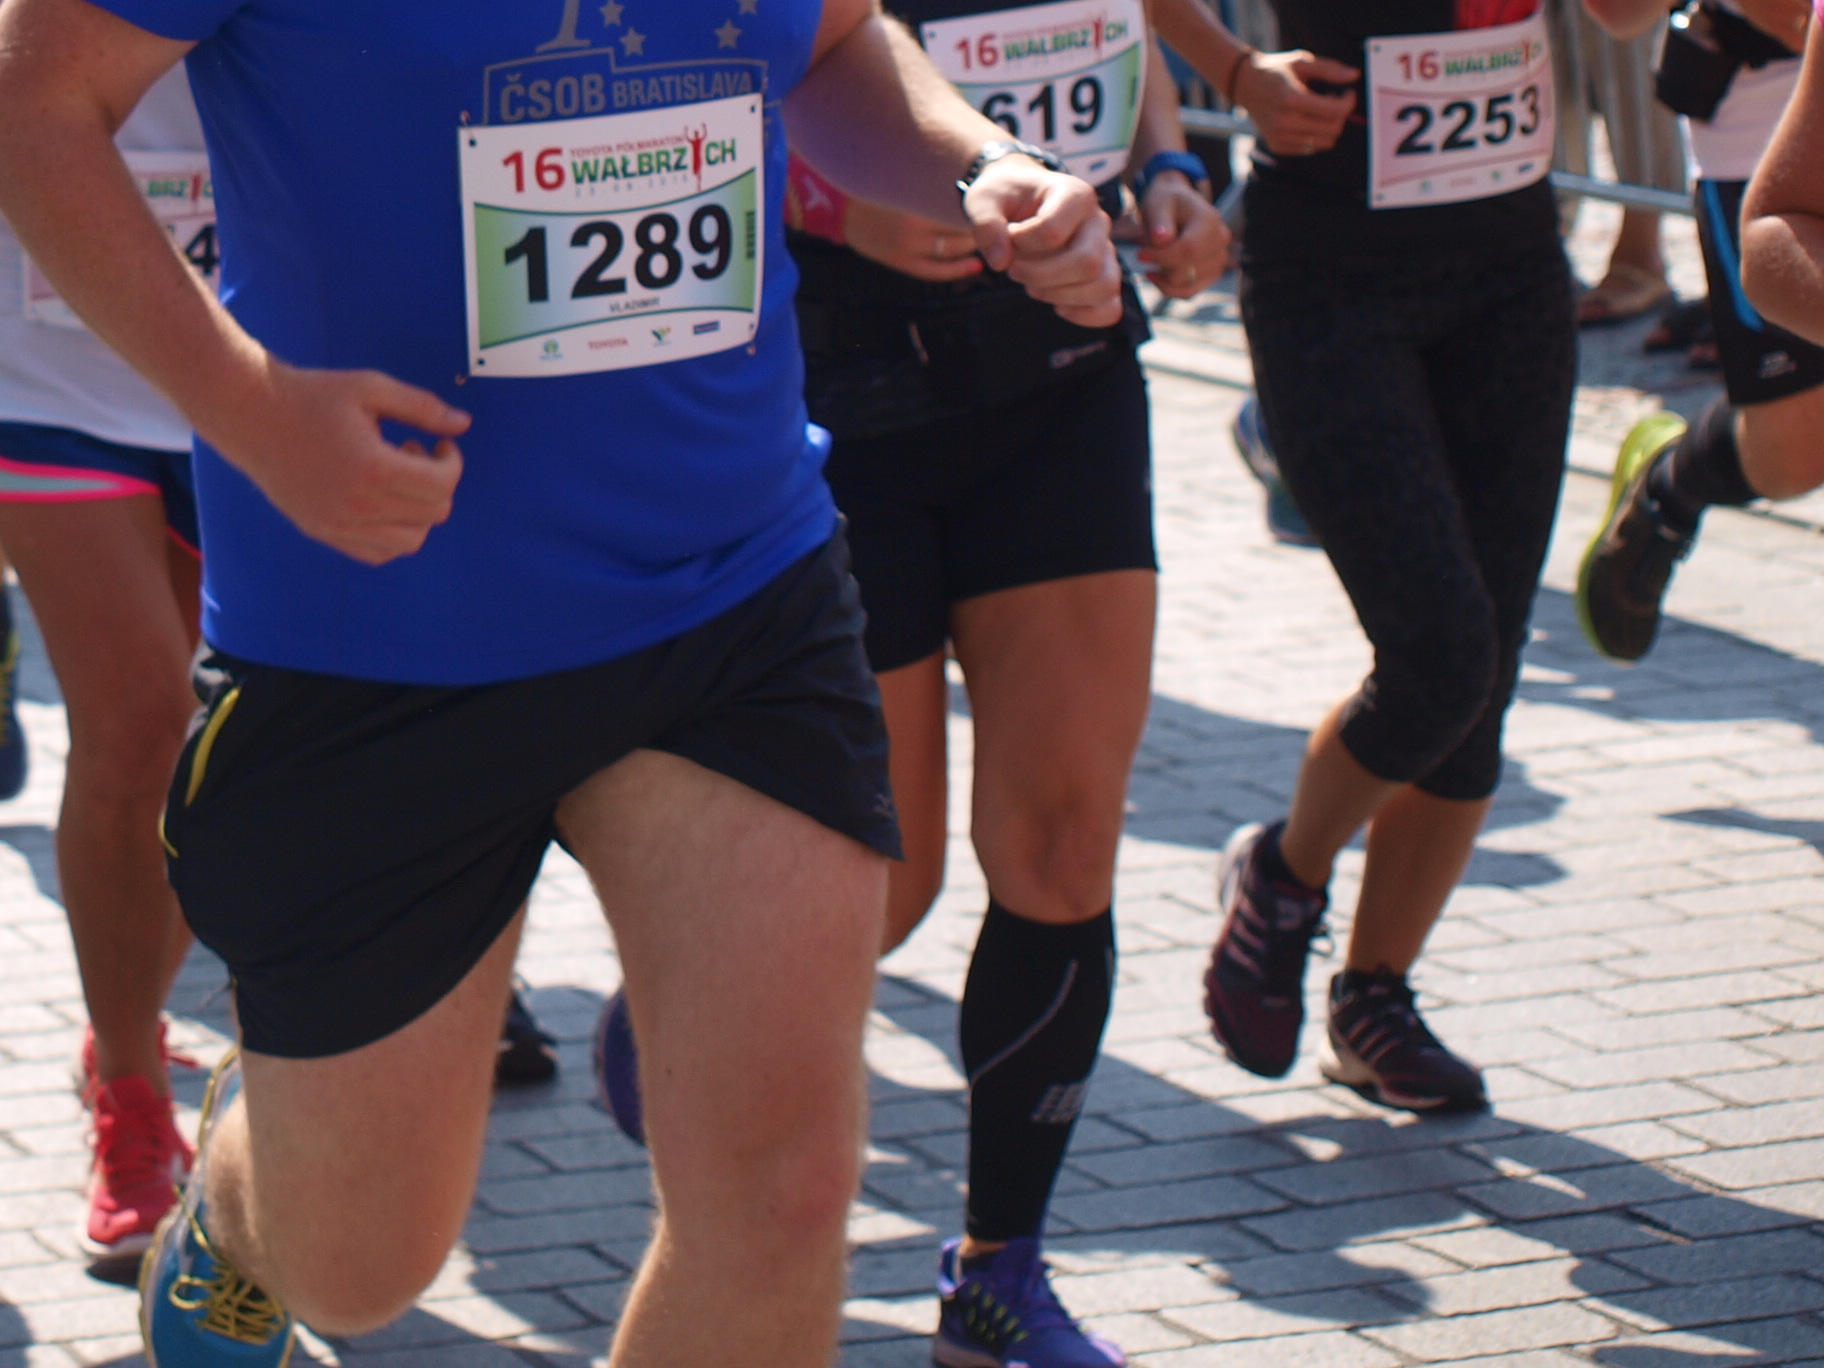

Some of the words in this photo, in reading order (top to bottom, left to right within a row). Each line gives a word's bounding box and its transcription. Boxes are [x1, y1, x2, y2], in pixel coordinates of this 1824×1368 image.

[955, 33, 999, 70] 16
[1396, 50, 1440, 81] 16
[499, 72, 606, 123] ČSOB
[612, 71, 754, 108] BRATISLAVA
[981, 75, 1104, 142] 619
[1394, 84, 1539, 157] 2253
[501, 146, 566, 194] 16
[504, 203, 733, 303] 1289
[587, 338, 629, 351] TOYOTA
